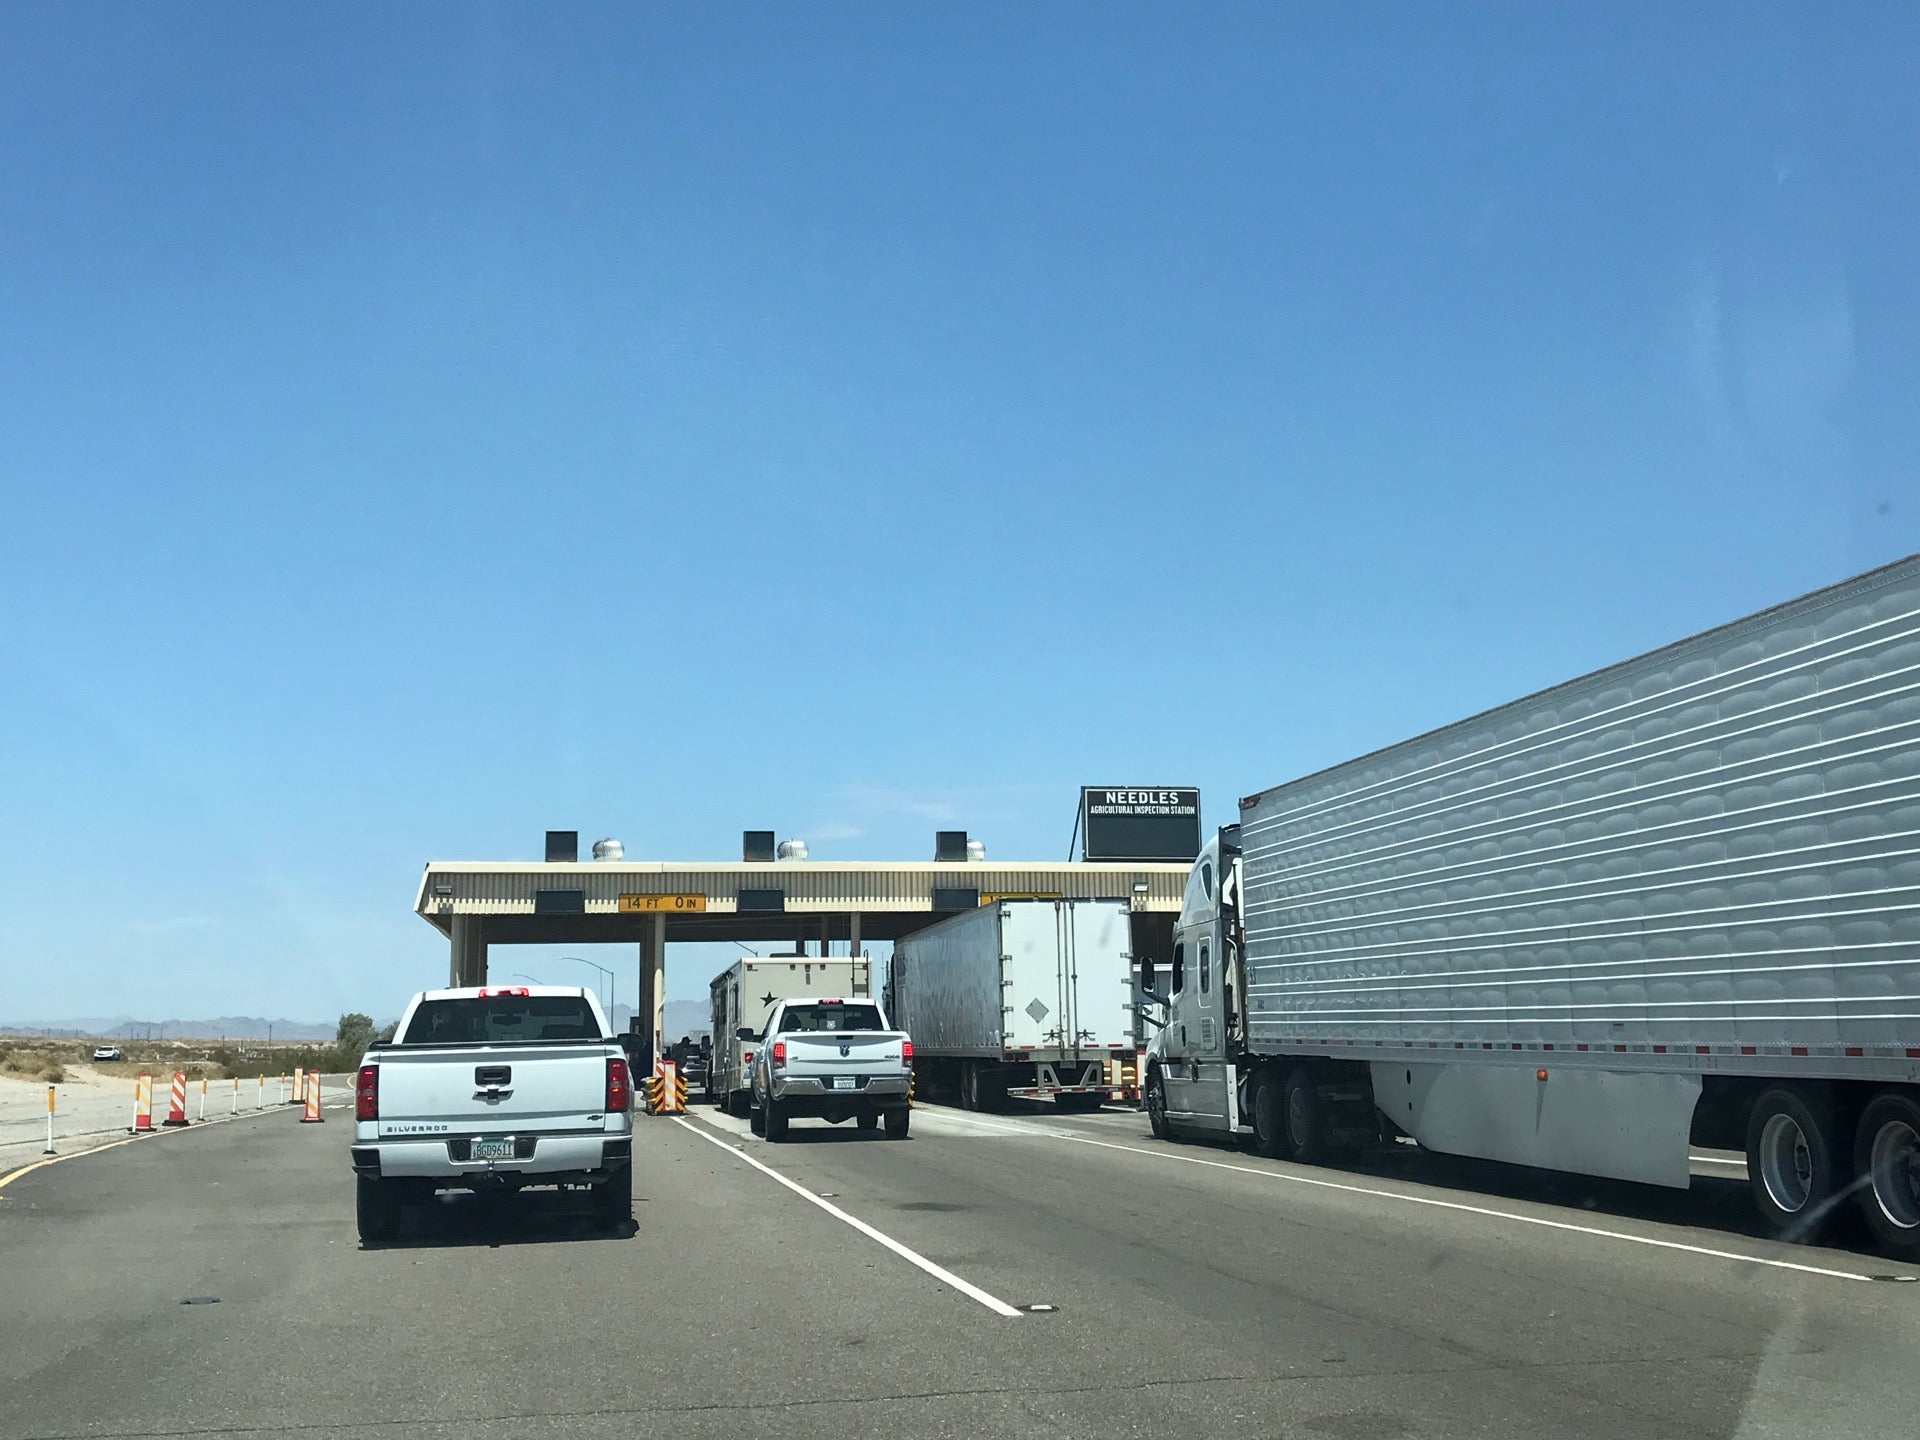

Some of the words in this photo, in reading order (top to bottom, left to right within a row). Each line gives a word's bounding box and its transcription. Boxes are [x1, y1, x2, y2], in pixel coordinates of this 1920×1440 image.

[1106, 792, 1179, 804] NEEDLES
[1090, 805, 1133, 814] AGRICULTURAL
[1134, 805, 1170, 814] INSPECTION
[1170, 806, 1195, 814] STATION
[627, 897, 640, 909] 14
[646, 900, 659, 909] FT
[686, 899, 696, 908] IN
